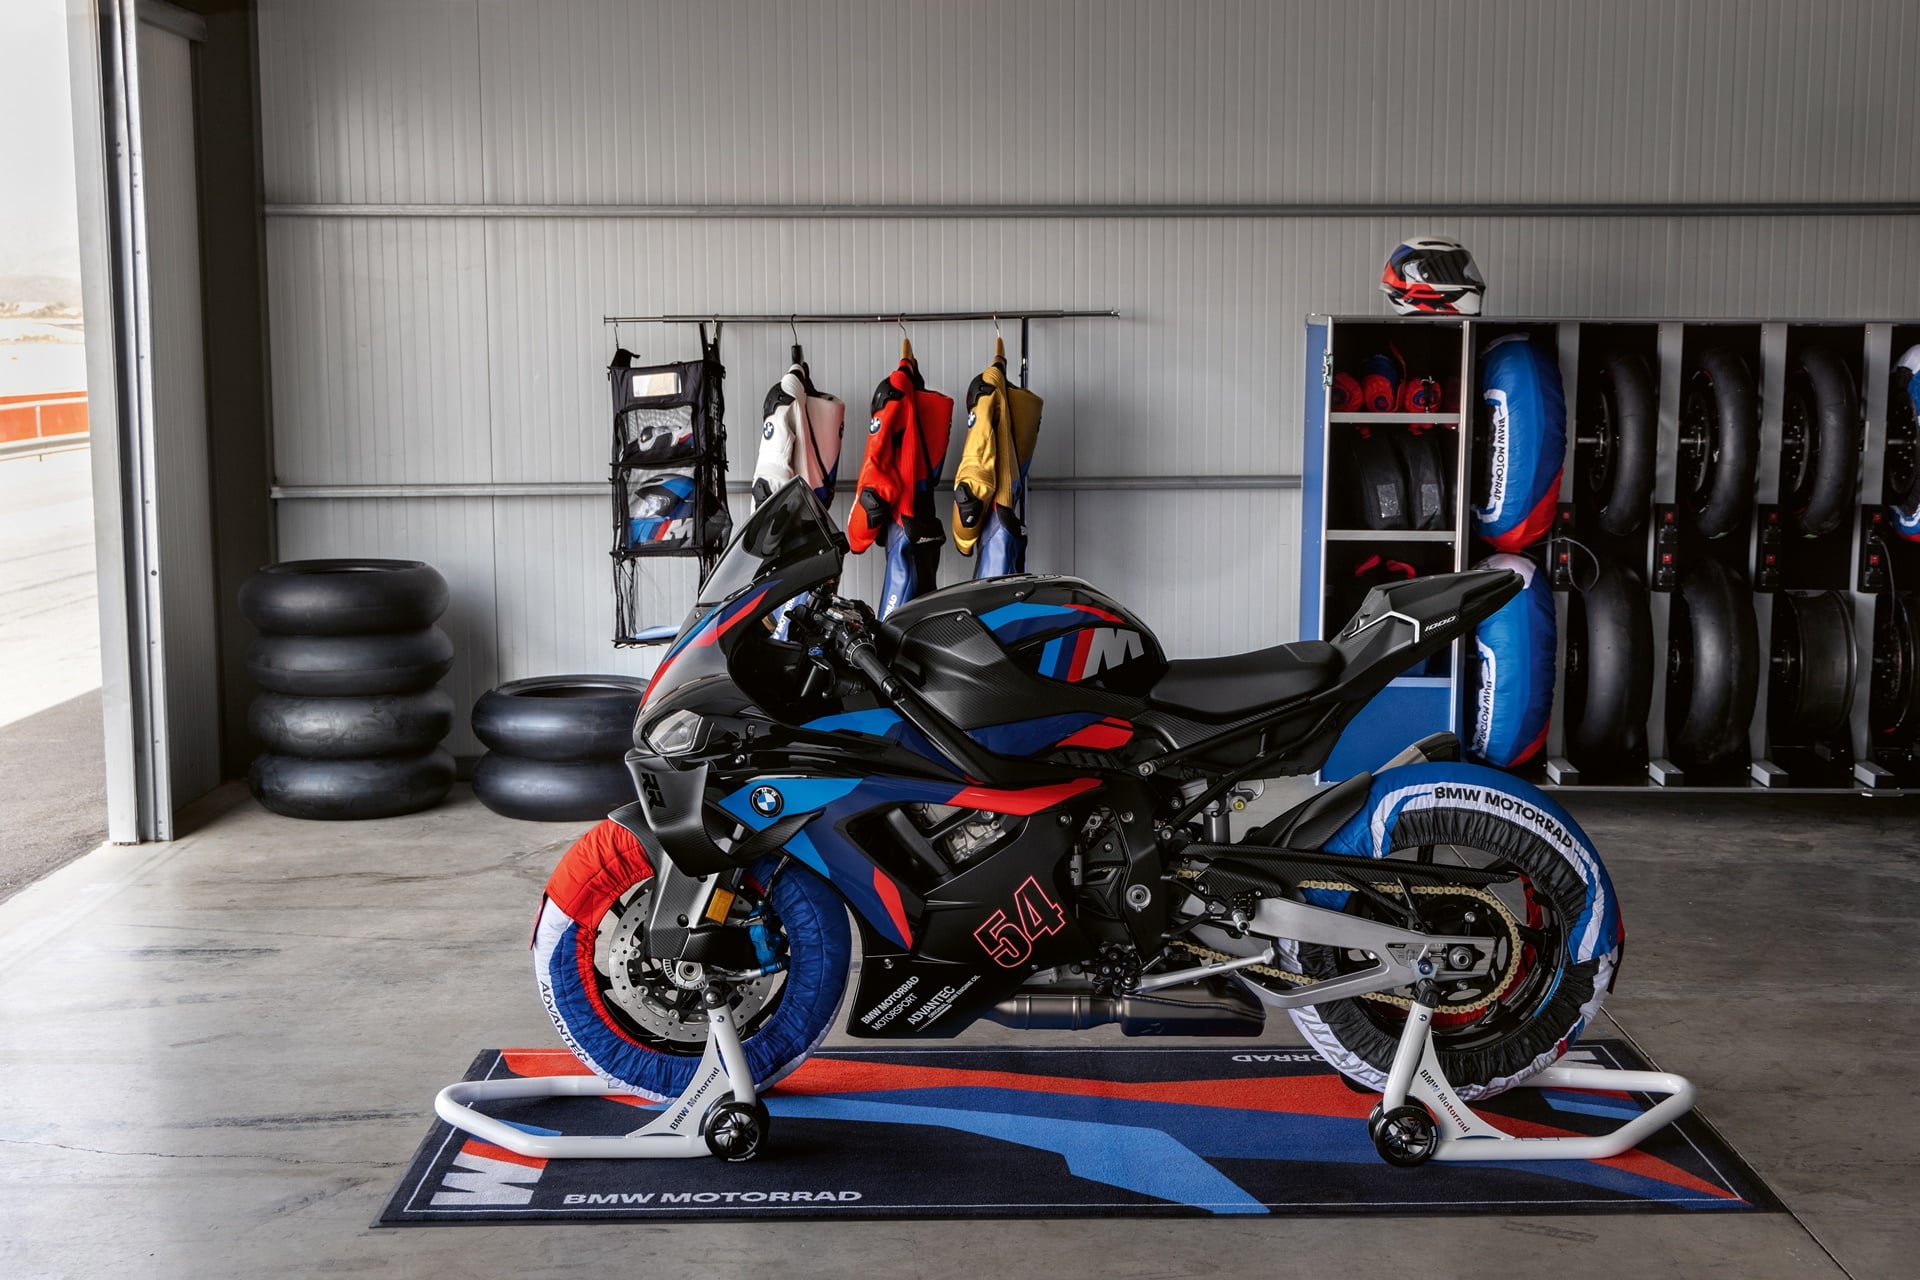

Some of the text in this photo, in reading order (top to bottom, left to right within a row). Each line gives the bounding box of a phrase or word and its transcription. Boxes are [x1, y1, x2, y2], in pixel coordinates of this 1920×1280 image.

[1425, 615, 1456, 632] 1000
[641, 772, 667, 809] RR
[1434, 786, 1573, 849] BMW MOTORRAD
[973, 875, 1066, 968] 54
[540, 980, 588, 1062] ADVANTEC
[861, 976, 919, 1024] BMW MOTORRAD
[871, 992, 918, 1031] MOTORSPORT
[907, 985, 955, 1025] ADVANTEC
[1231, 1054, 1327, 1062] ORRAD
[670, 1066, 720, 1131] BMW Motorrad
[1420, 1069, 1471, 1133] BMW Motorrad
[562, 1191, 863, 1204] BMW MOTORRAD
